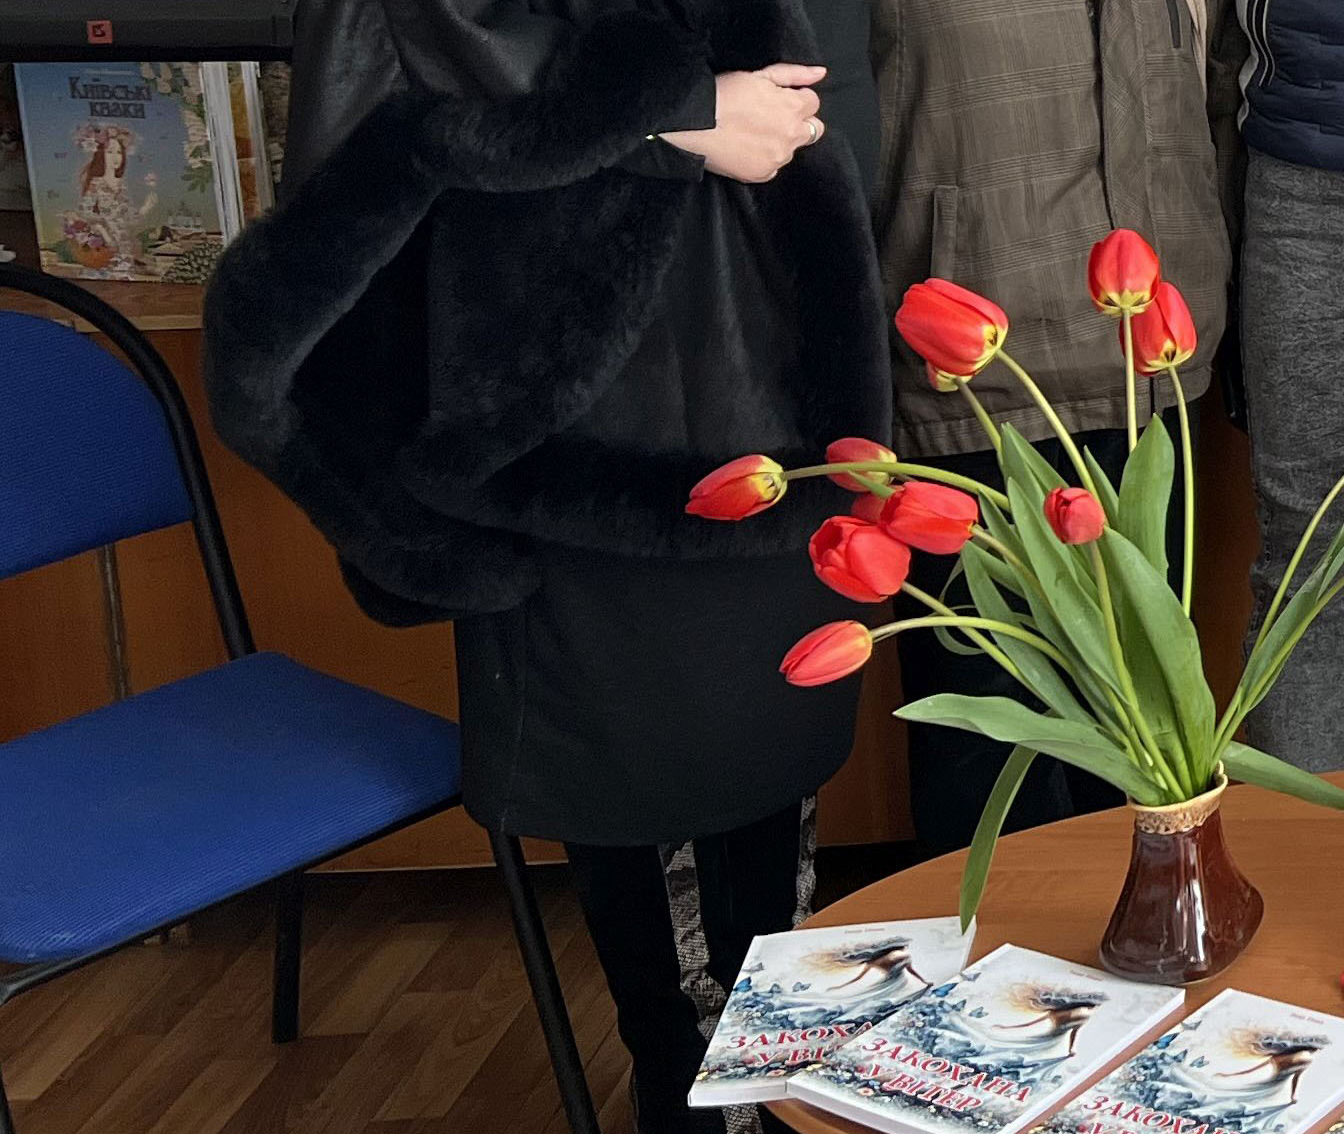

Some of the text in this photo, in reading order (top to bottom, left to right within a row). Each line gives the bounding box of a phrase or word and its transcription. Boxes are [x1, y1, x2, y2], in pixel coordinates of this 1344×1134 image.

[68, 76, 152, 101] Київські
[89, 101, 146, 120] казки
[754, 1049, 782, 1067] У
[857, 1033, 1033, 1104] ЗАКОХАНА
[881, 1068, 983, 1114] ВІТЕР
